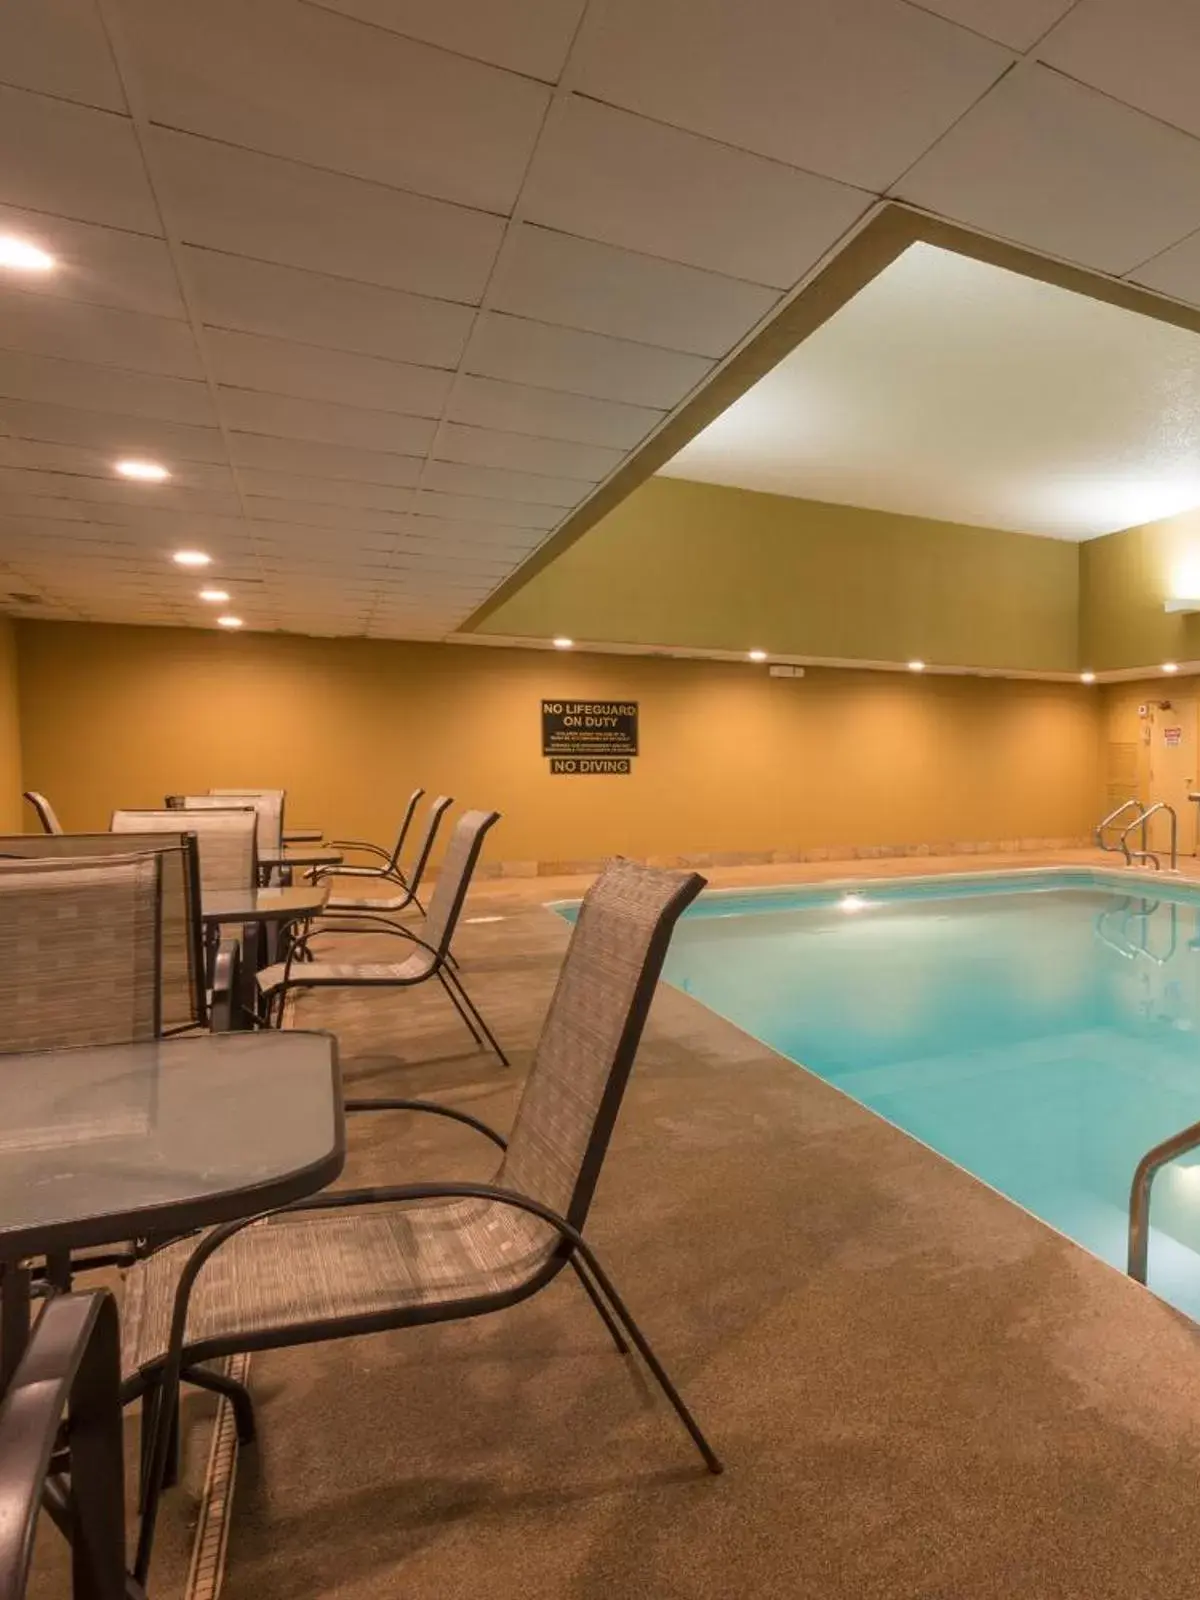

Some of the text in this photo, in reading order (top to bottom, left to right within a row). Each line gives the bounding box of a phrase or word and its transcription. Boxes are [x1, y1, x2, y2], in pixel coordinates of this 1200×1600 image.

[543, 703, 636, 716] NO LIFEGUARD
[563, 716, 618, 728] ON DUTY
[554, 761, 628, 773] NO DIVING
